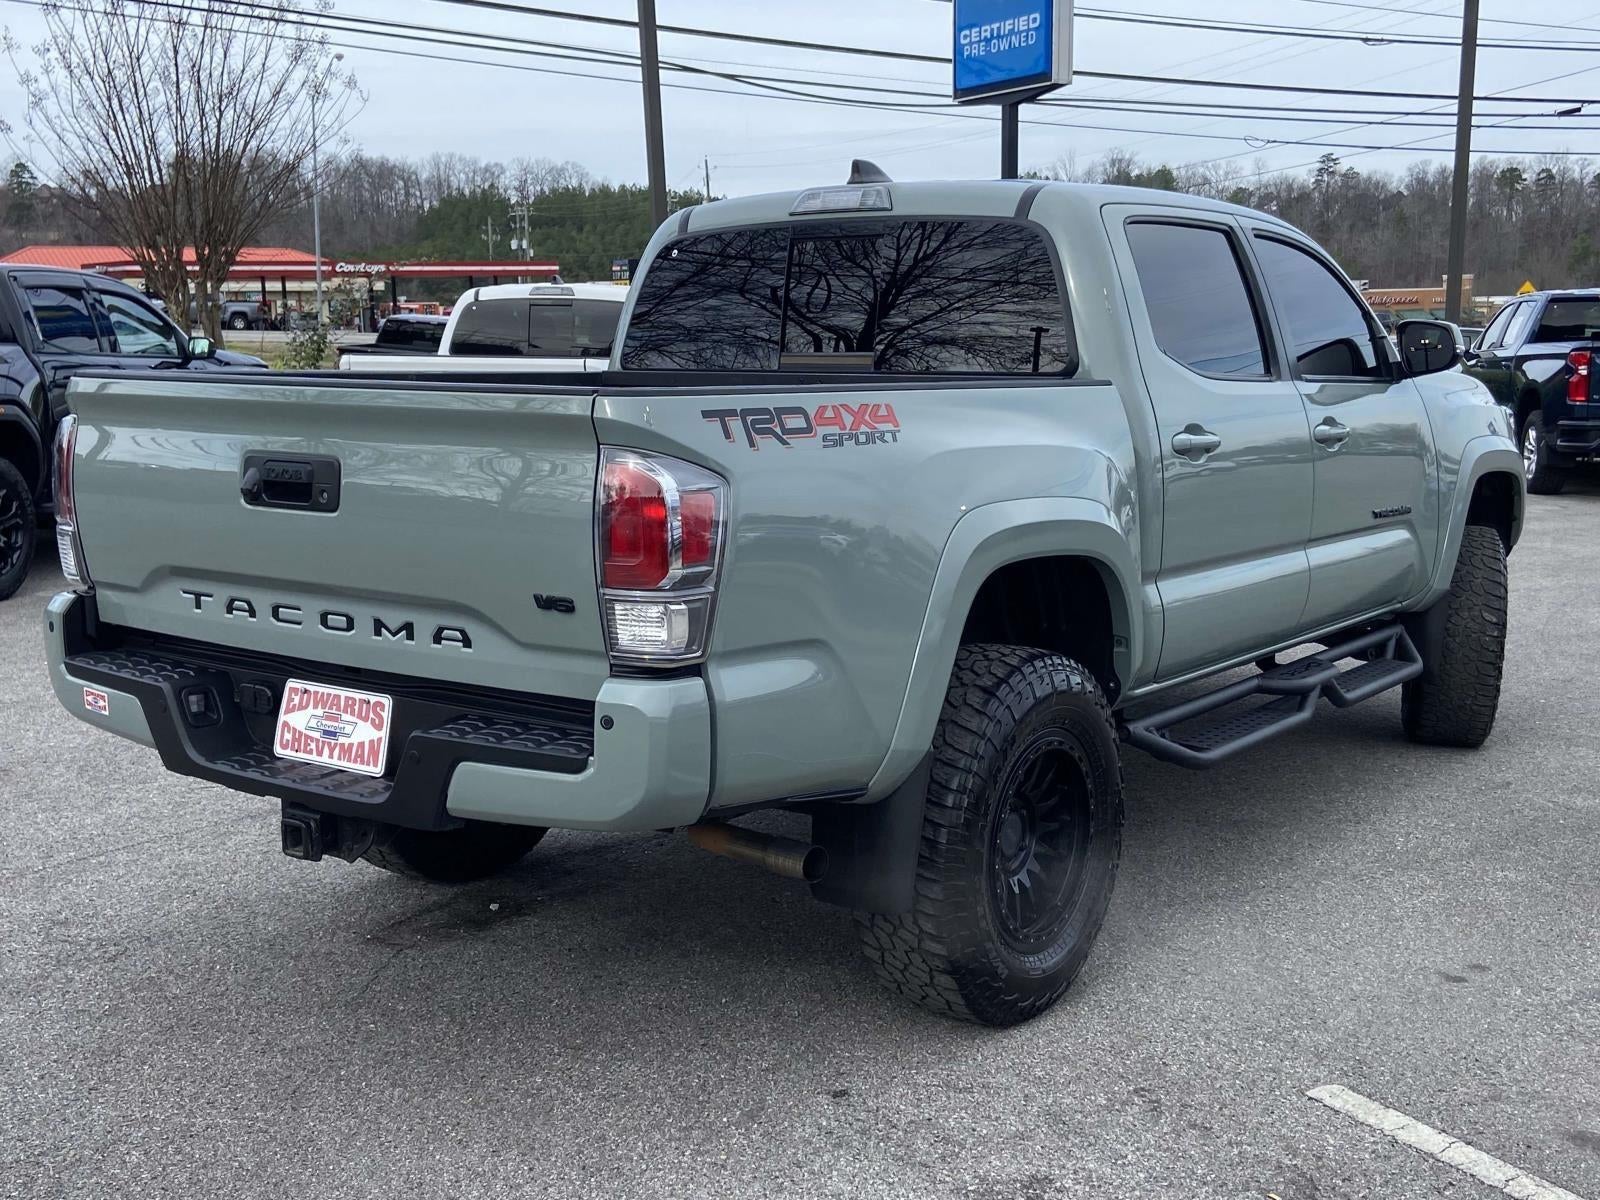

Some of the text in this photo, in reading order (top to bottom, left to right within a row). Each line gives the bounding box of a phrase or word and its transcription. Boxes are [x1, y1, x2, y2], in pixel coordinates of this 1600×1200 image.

[960, 13, 1040, 45] CERTIFIED
[963, 31, 1036, 59] PRE-OWNED
[701, 406, 817, 451] TRD
[822, 429, 900, 449] SPORT
[533, 593, 576, 613] V6
[180, 588, 474, 652] TACOMA
[283, 686, 386, 732] EDWARDS
[315, 720, 346, 733] Chevrolet
[279, 719, 383, 769] CHEVYMAN
